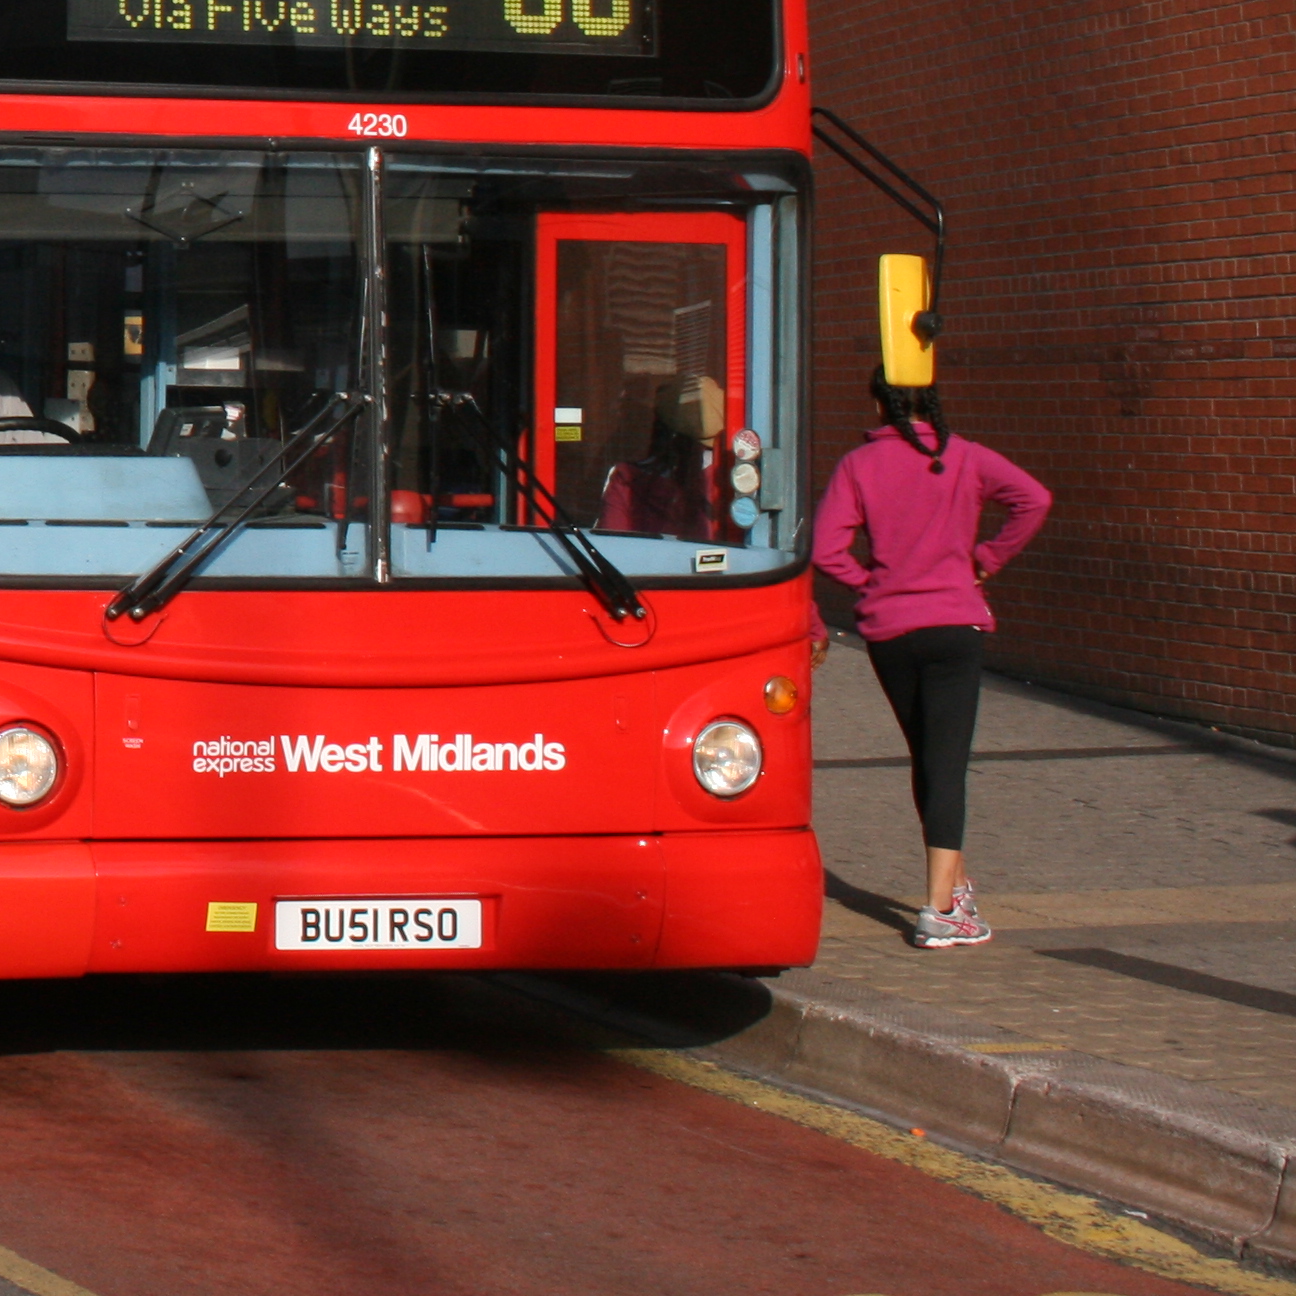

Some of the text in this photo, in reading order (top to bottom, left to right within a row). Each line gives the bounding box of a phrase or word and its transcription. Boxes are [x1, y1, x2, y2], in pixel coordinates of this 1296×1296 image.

[347, 111, 408, 138] 4230
[193, 736, 275, 757] national
[280, 734, 566, 772] West Midlands
[193, 757, 276, 777] express
[300, 907, 458, 942] BU51 RSO
